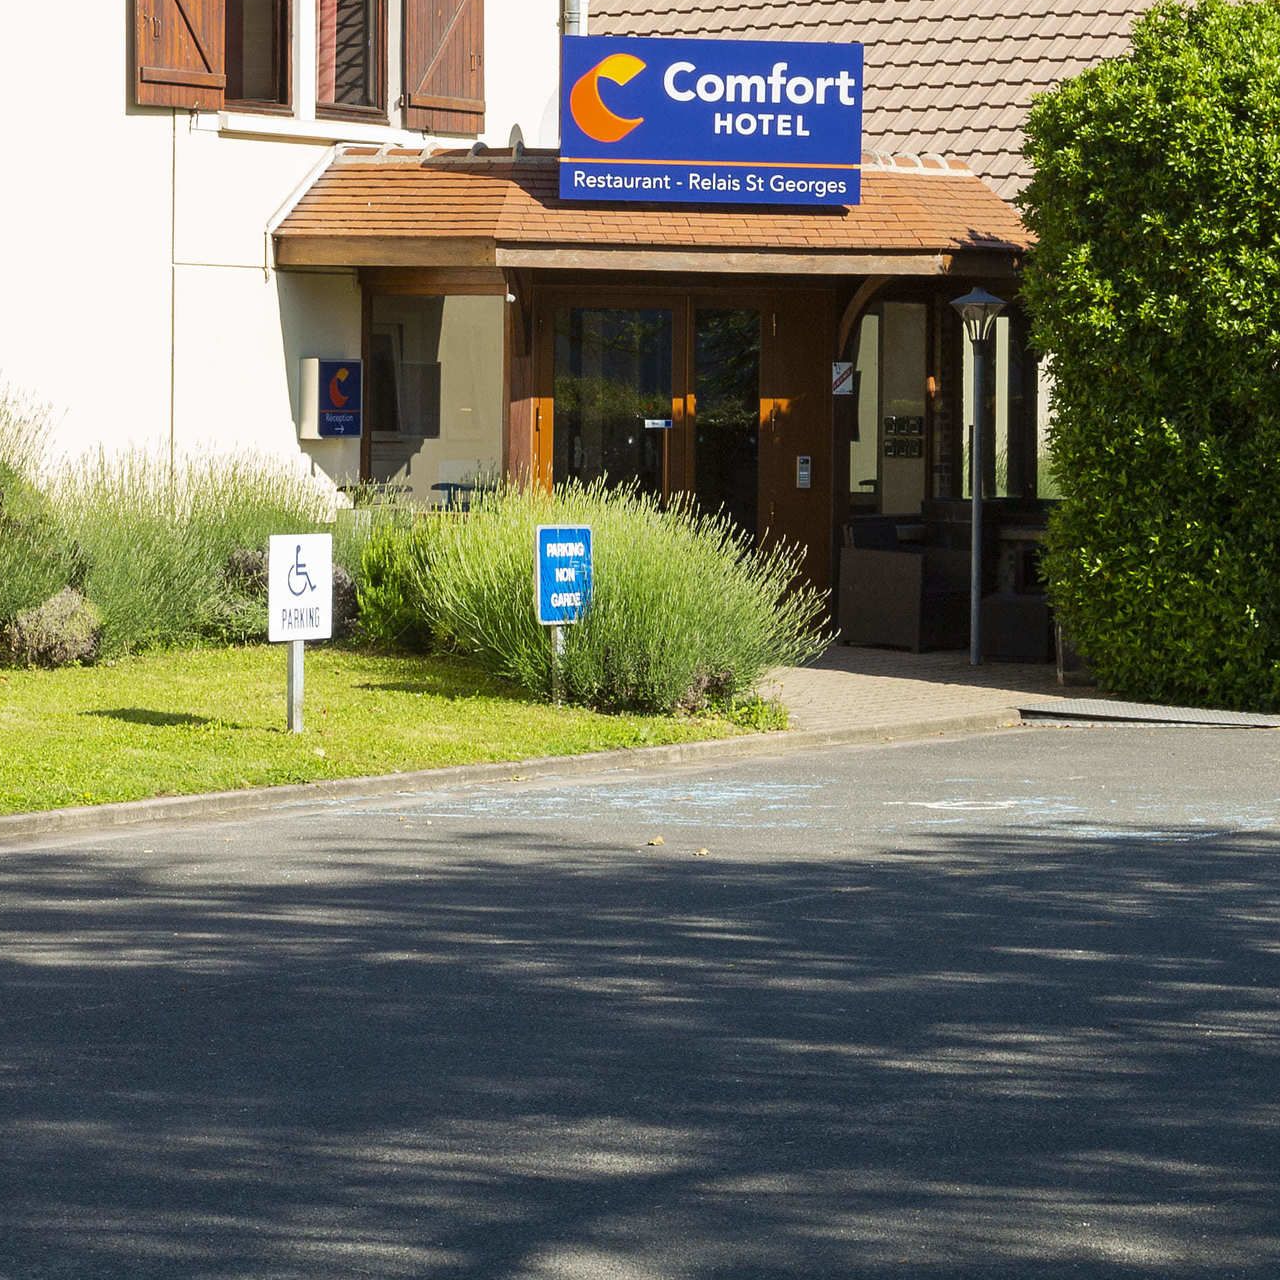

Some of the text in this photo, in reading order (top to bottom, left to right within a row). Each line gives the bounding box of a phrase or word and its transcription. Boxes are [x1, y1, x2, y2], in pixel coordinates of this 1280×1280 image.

[663, 61, 855, 106] Comfort
[713, 113, 811, 137] HOTEL
[573, 170, 671, 190] Restaurant
[688, 173, 740, 191] Relais
[746, 174, 765, 192] St
[769, 175, 847, 198] Georges
[546, 542, 585, 558] PARKING
[555, 567, 576, 582] NON
[282, 607, 320, 630] PARKING
